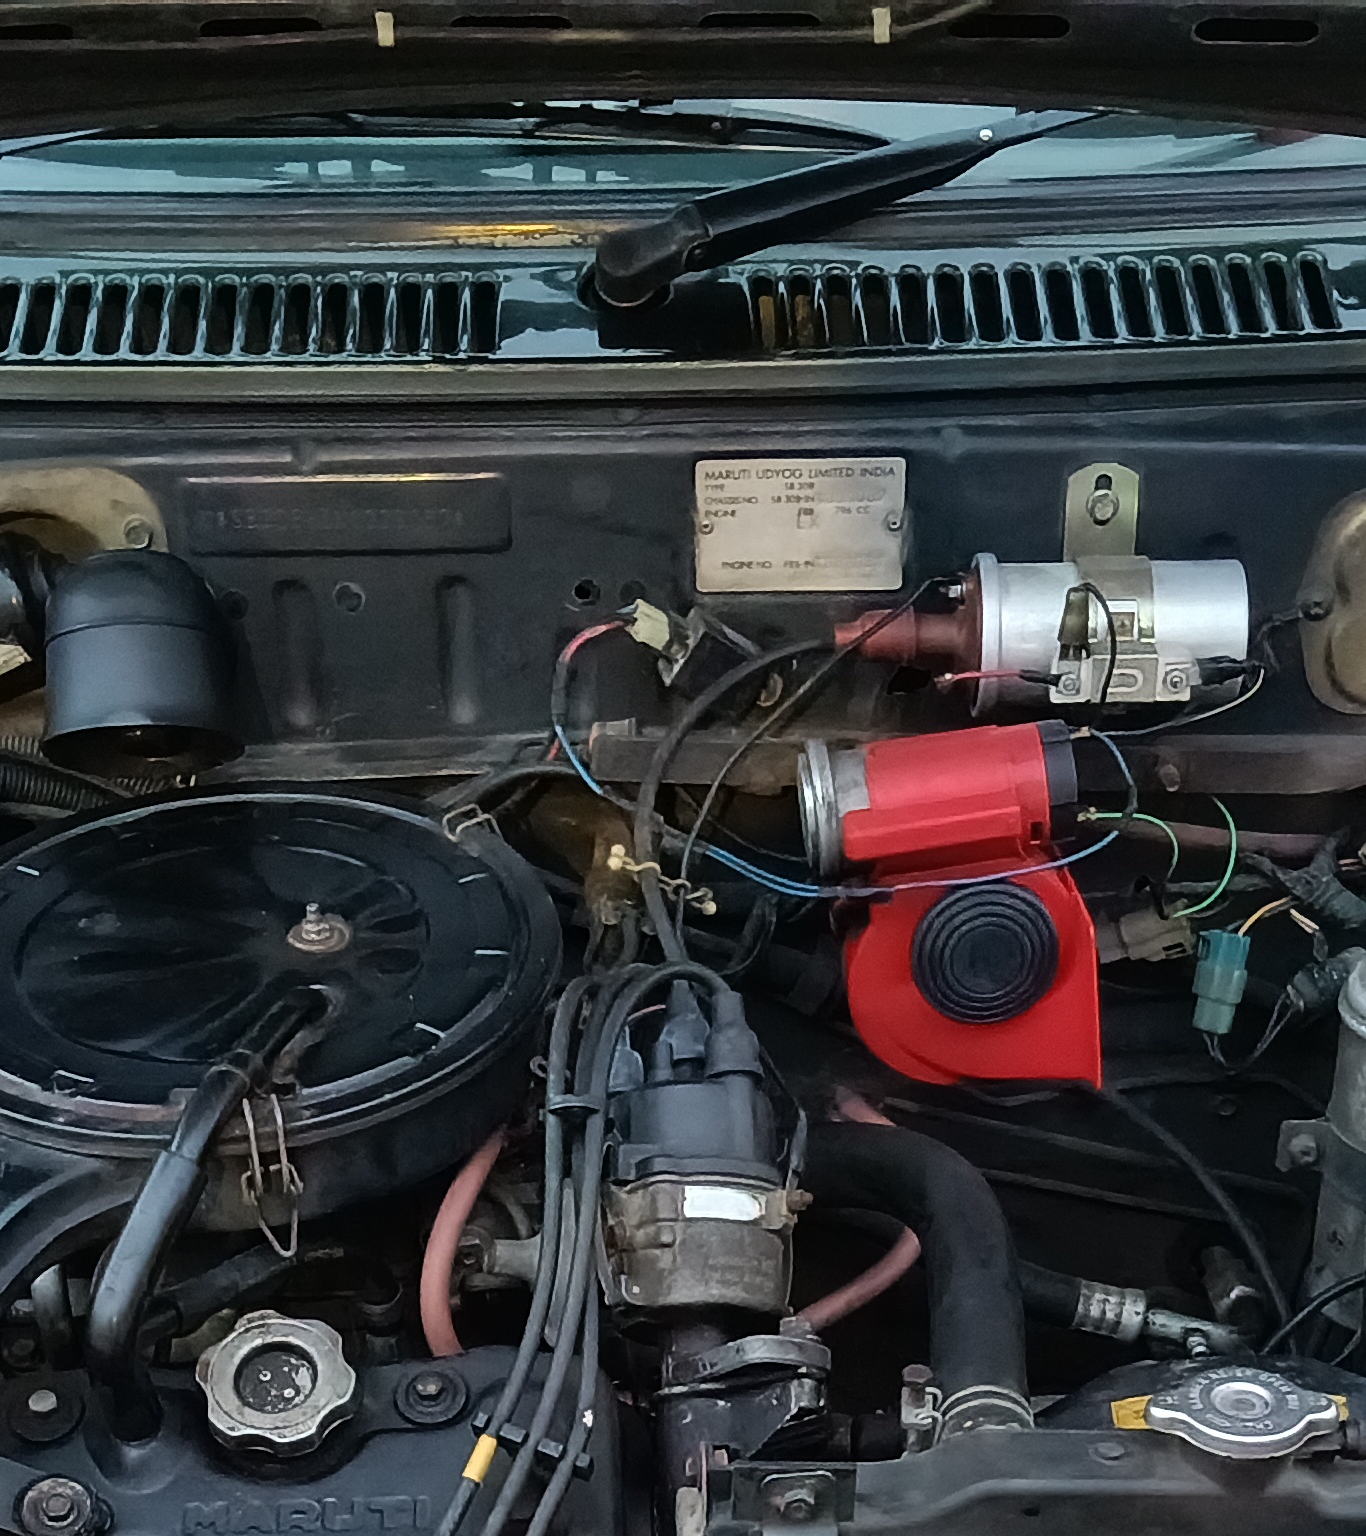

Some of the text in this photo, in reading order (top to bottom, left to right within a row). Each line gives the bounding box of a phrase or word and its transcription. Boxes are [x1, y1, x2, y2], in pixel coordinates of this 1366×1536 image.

[704, 466, 896, 481] MARUTI UDYOG LIMITED INDIA
[856, 505, 871, 515] CC
